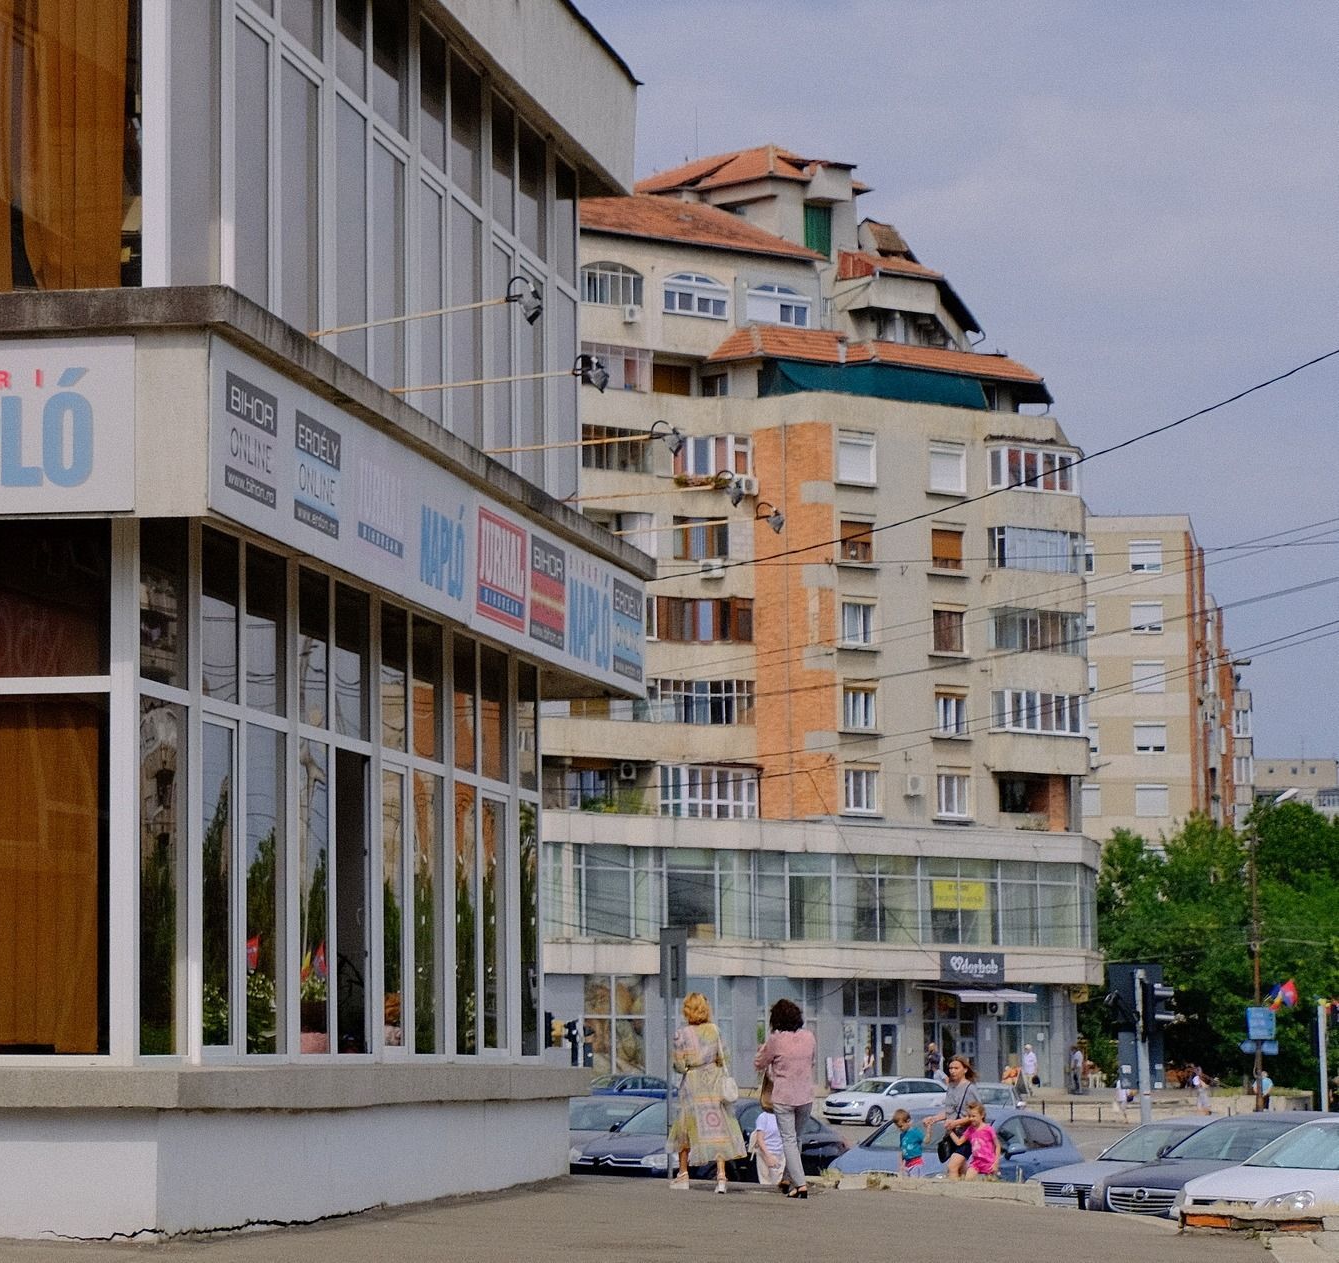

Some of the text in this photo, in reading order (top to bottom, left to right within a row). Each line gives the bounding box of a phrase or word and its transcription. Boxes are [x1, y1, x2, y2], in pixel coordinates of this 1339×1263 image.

[231, 386, 274, 430] BIHOR
[230, 427, 272, 474] ONLINE
[298, 424, 339, 465] ERDÉLY
[227, 471, 275, 504] www.bihon.ro
[299, 464, 335, 506] ONLINE
[420, 503, 465, 601] NAPLÓ
[480, 517, 524, 598] JURNAL
[533, 546, 563, 582] BIHOR
